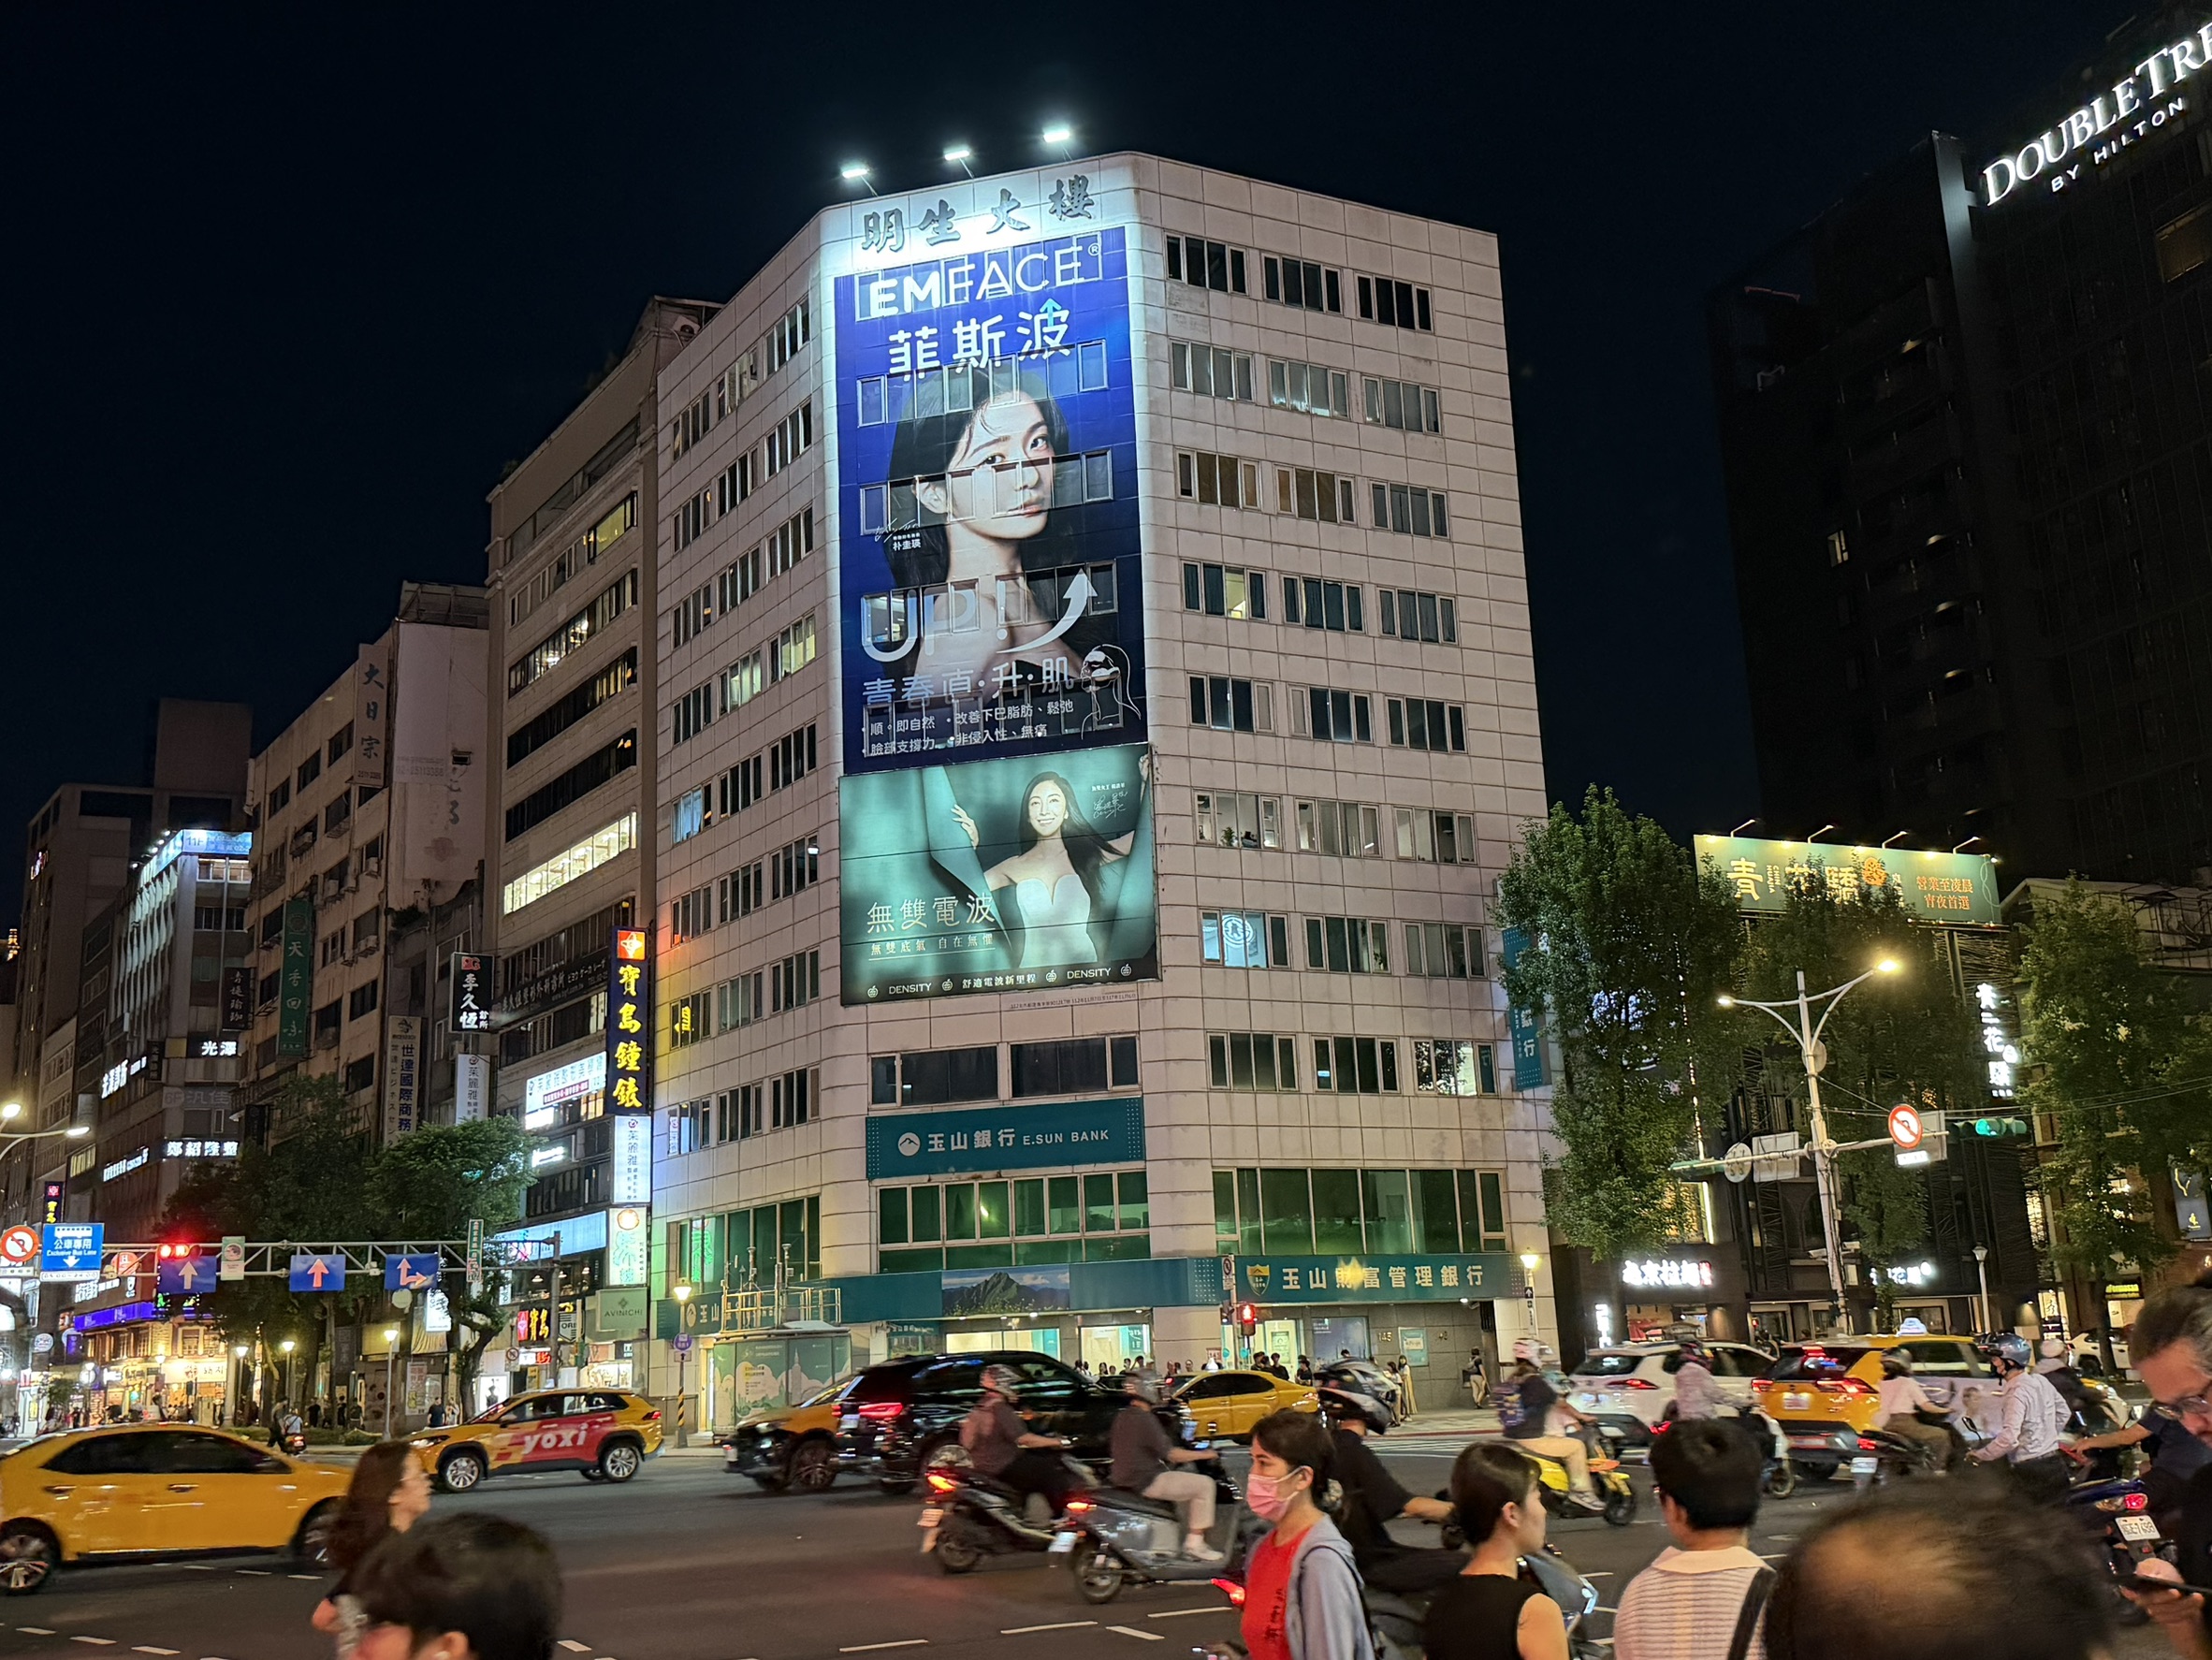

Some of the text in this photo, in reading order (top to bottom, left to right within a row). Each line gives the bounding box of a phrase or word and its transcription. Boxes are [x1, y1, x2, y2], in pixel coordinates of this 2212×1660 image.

[2051, 97, 2184, 193] BY HILTON
[861, 174, 1095, 254] 明生大樓
[888, 304, 1072, 382] 菲斯波
[1773, 864, 1782, 887] CHIN
[1915, 875, 1974, 895] 營業至凌晨
[866, 892, 996, 934] 無雙電波
[1923, 893, 1971, 911] 宵夜首選
[870, 932, 995, 956] 無雙底氣 自在無懼
[888, 968, 1112, 996] DENSITY 舒適電波新里程 DENSITY
[612, 964, 644, 1109] 寶島鐘錶
[927, 1128, 1110, 1154] 玉山銀行 E.SUN BANK
[53, 1238, 93, 1250] 公車專用
[1281, 1264, 1484, 1290] 玉山財富管理銀行
[521, 1423, 589, 1455] yoxi
